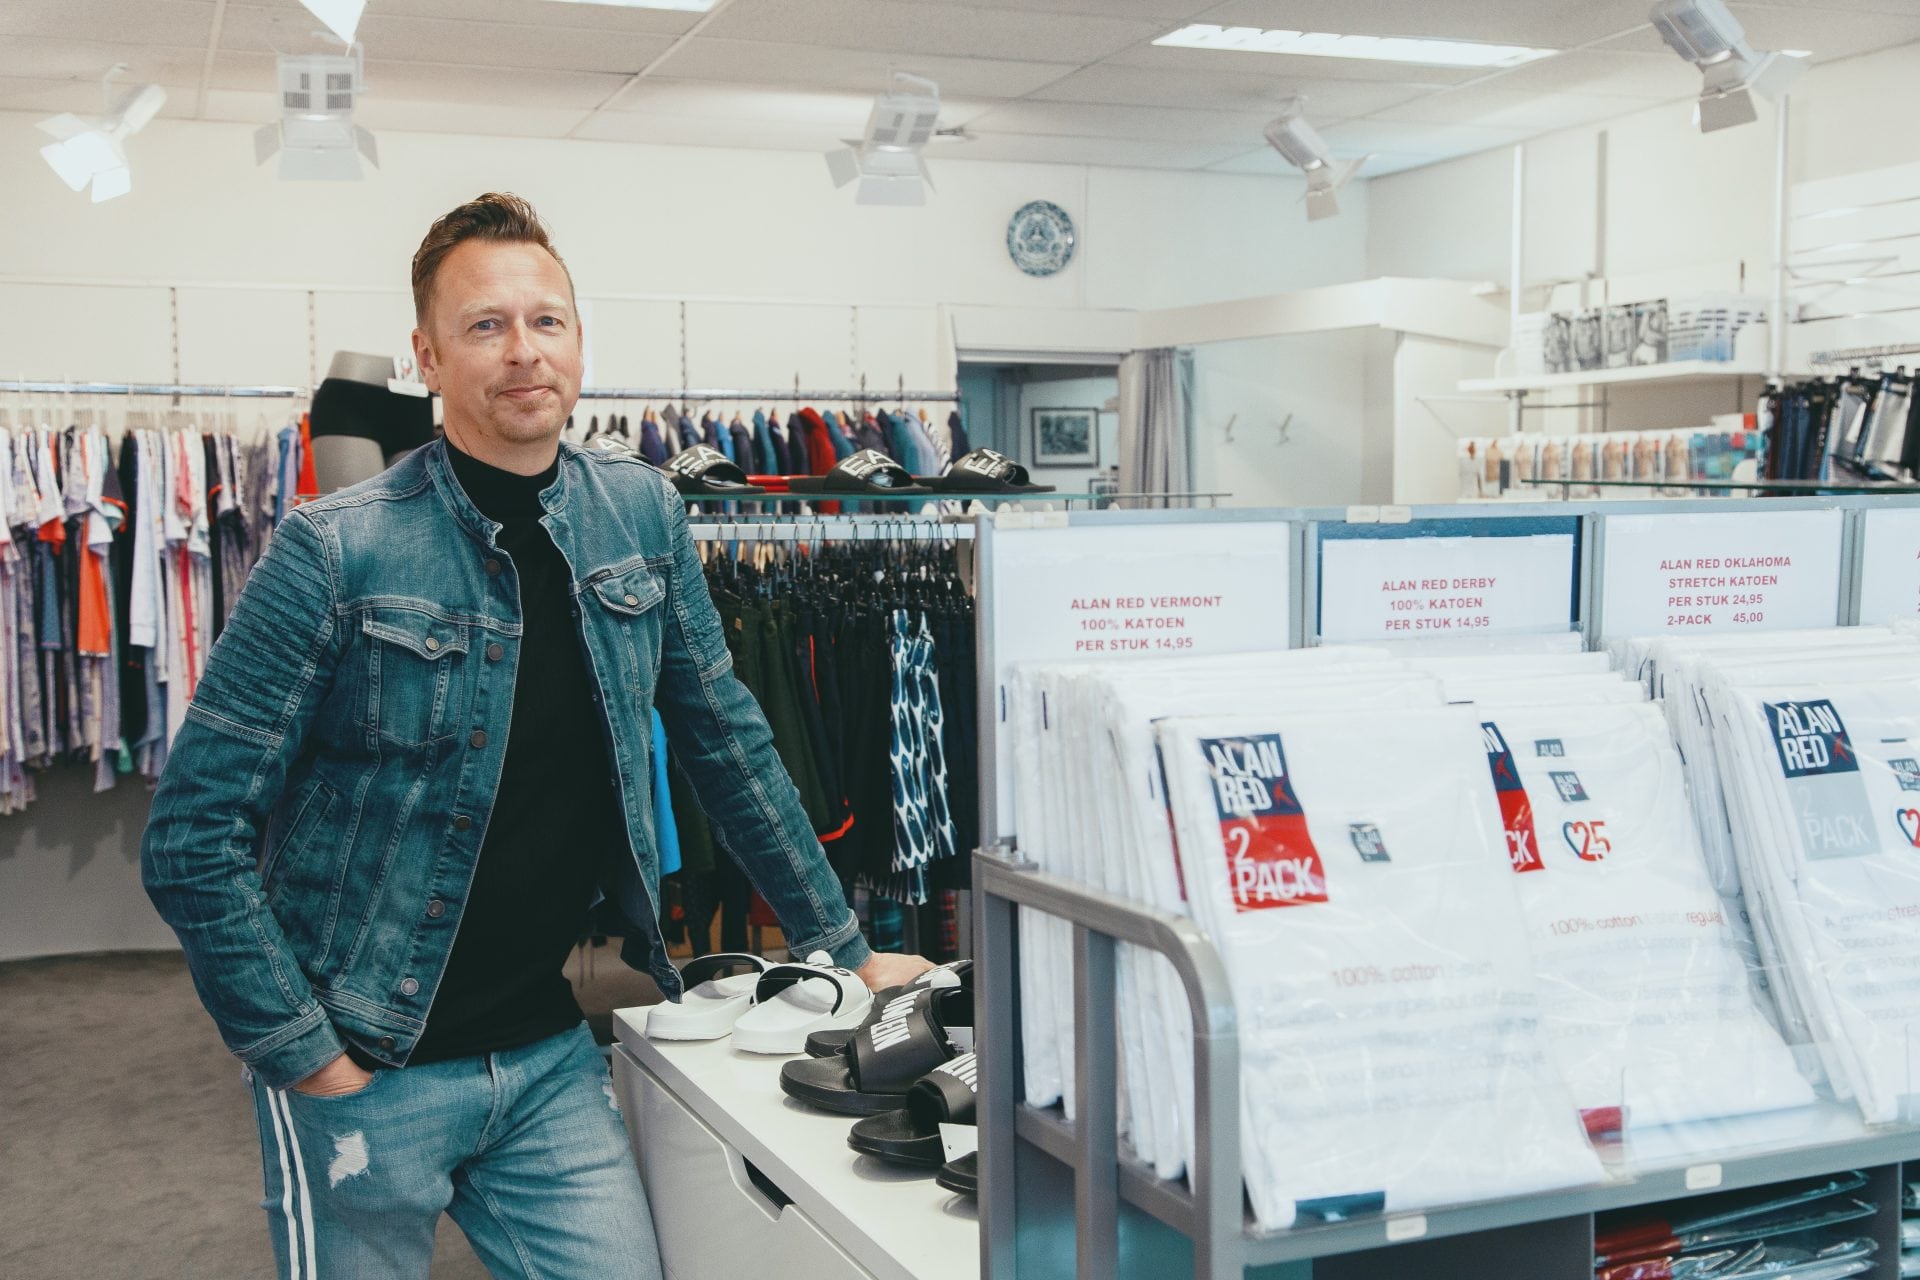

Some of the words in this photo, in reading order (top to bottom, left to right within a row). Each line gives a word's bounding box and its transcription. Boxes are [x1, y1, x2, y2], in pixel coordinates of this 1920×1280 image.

[1660, 560, 1692, 570] ALAN
[1696, 559, 1720, 569] RED
[1724, 557, 1791, 568] OKLAHOMA
[1382, 581, 1416, 591] ALAN
[1421, 579, 1448, 590] RED
[1453, 578, 1496, 589] DERBY
[1669, 577, 1725, 588] STRETCH
[1730, 575, 1778, 587] KATOEN
[1071, 598, 1110, 610] ALAN
[1116, 597, 1145, 609] RED
[1150, 596, 1223, 608] VERMONT
[1390, 599, 1424, 611] 100%
[1429, 597, 1482, 609] KATOEN
[1668, 597, 1692, 607] PER
[1696, 595, 1729, 606] STUK
[1733, 594, 1763, 606] 24,95
[1081, 618, 1119, 631] 100%
[1125, 617, 1185, 629] KATOEN
[1386, 619, 1411, 631] PER
[1416, 618, 1451, 630] STUK
[1456, 616, 1490, 629] 14,95
[1667, 614, 1712, 626] 2-PACK
[1733, 612, 1763, 624] 45,00
[1076, 639, 1104, 651] PER
[1110, 638, 1149, 650] STUK
[1155, 637, 1193, 650] 14,95
[1777, 703, 1841, 738] ALAN
[1210, 740, 1284, 779] ALAN
[1780, 735, 1830, 770] RED
[1217, 775, 1273, 814] RED
[1803, 813, 1872, 850] PACK
[1229, 827, 1254, 865] 2
[1236, 857, 1322, 904] PACK
[1550, 917, 1594, 937] 100%
[1596, 913, 1644, 930] cotton
[1331, 965, 1386, 988] 100%
[1391, 963, 1446, 983] cotton
